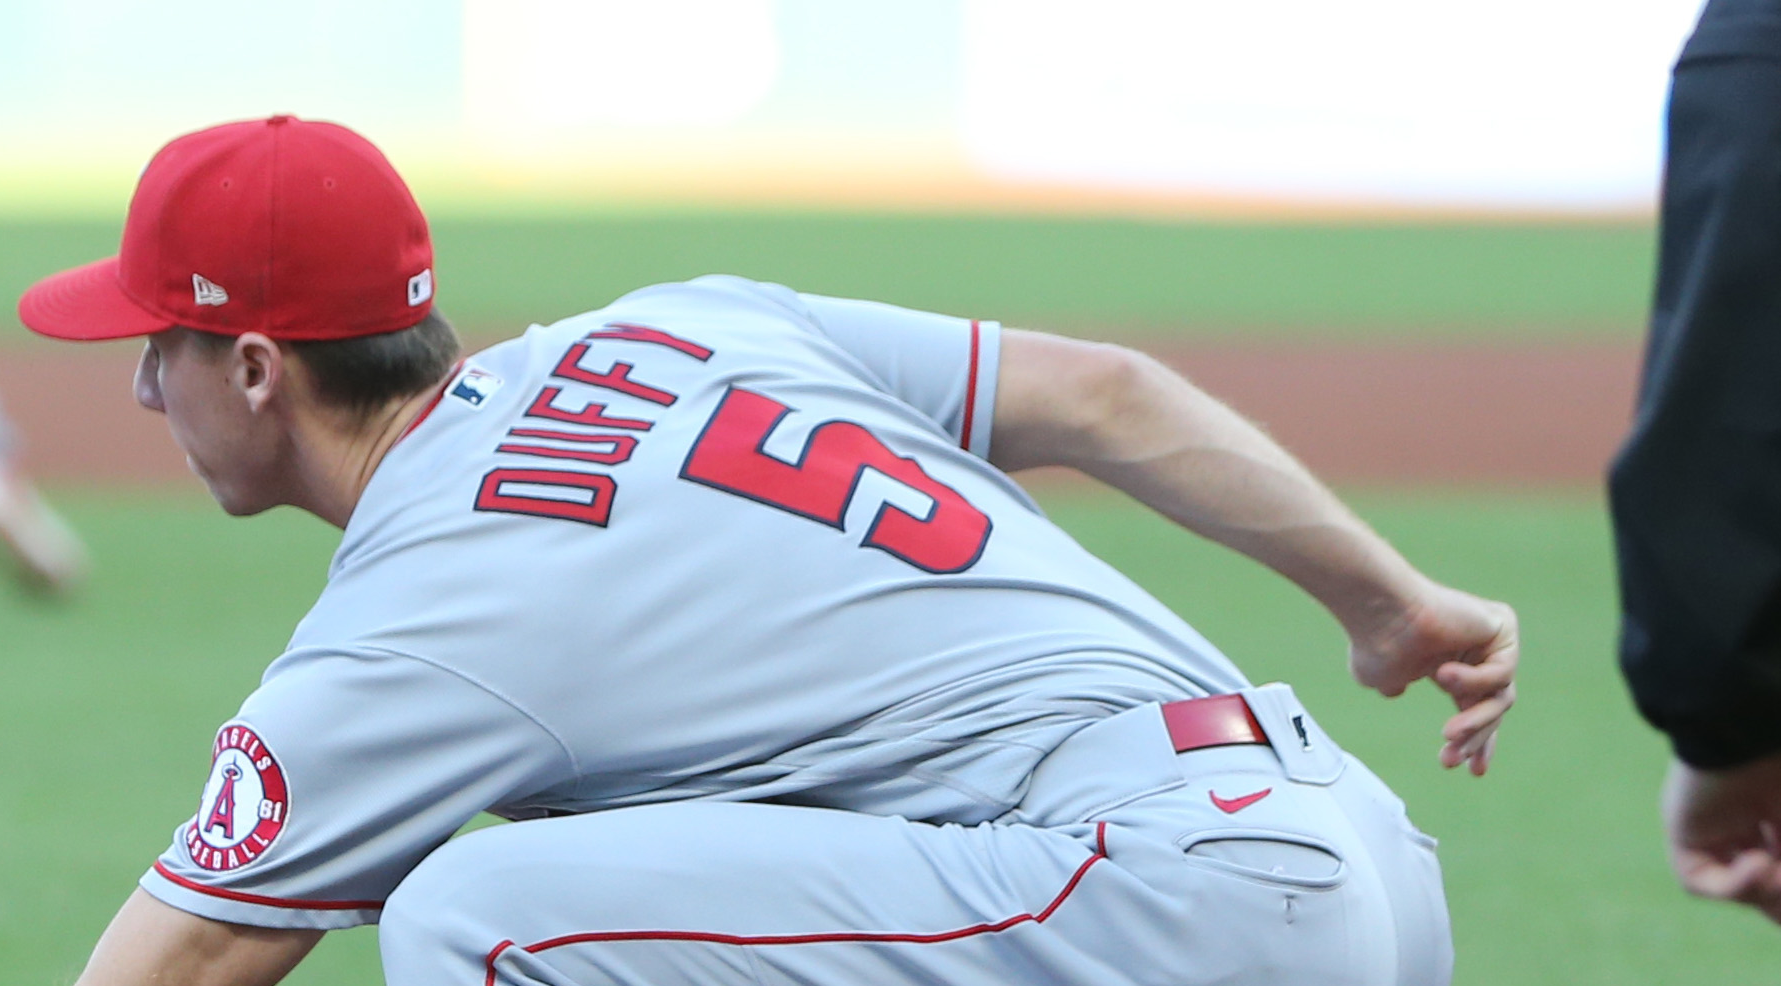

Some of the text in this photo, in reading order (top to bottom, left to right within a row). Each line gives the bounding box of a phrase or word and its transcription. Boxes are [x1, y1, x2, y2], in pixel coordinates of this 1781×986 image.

[473, 322, 715, 528] DUFFY
[677, 384, 993, 574] 5
[215, 728, 272, 771] NGELS
[204, 768, 235, 840] A
[186, 828, 269, 869] ASEBALL
